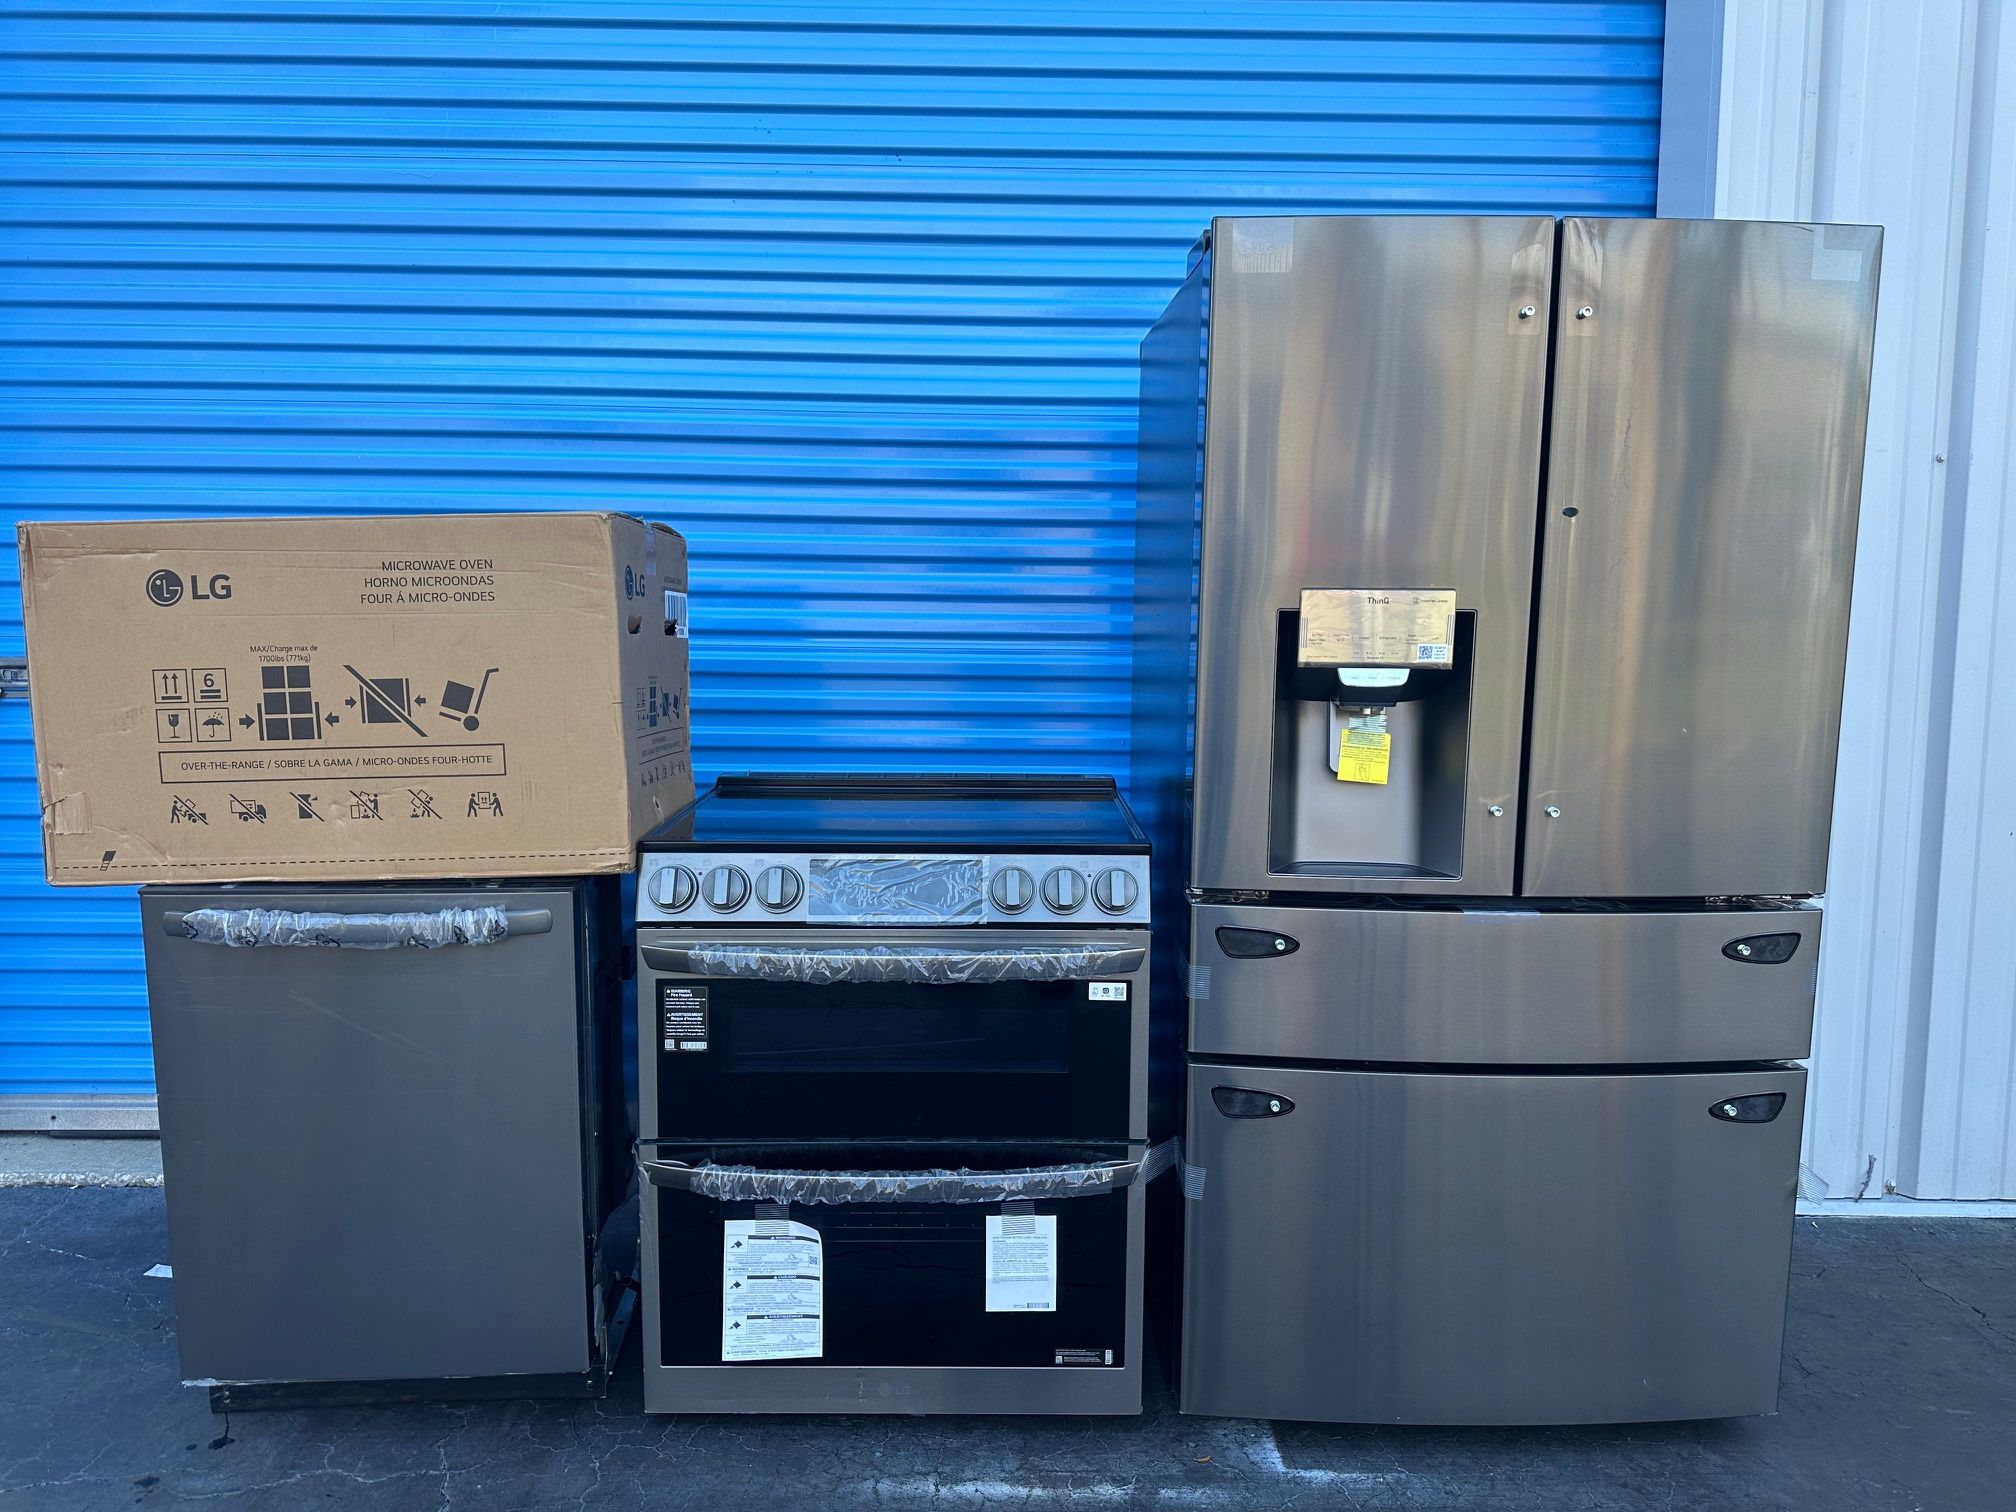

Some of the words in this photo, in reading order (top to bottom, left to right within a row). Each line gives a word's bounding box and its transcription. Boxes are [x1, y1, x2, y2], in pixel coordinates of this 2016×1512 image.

[381, 560, 456, 571] MICROWAVE
[459, 559, 493, 570] OVEN
[190, 574, 232, 600] LG
[364, 577, 408, 588] HORNO
[411, 575, 494, 587] MICROONDAS
[634, 572, 646, 597] LG
[360, 594, 393, 604] FOUR
[408, 591, 495, 603] MICRO-ONDES
[1367, 597, 1390, 605] ThinQ
[250, 645, 293, 653] MAX/Charge
[258, 654, 284, 662] 1700lbs
[285, 653, 311, 663] (771kg)
[203, 673, 214, 687] 6
[181, 760, 264, 771] OVER-THE-RANGE
[274, 759, 305, 769] SOBRE
[308, 759, 320, 768] LA
[323, 757, 352, 767] GAMA
[362, 756, 430, 767] MICRO-ONDES
[432, 754, 492, 765] FOUR-HOTTE
